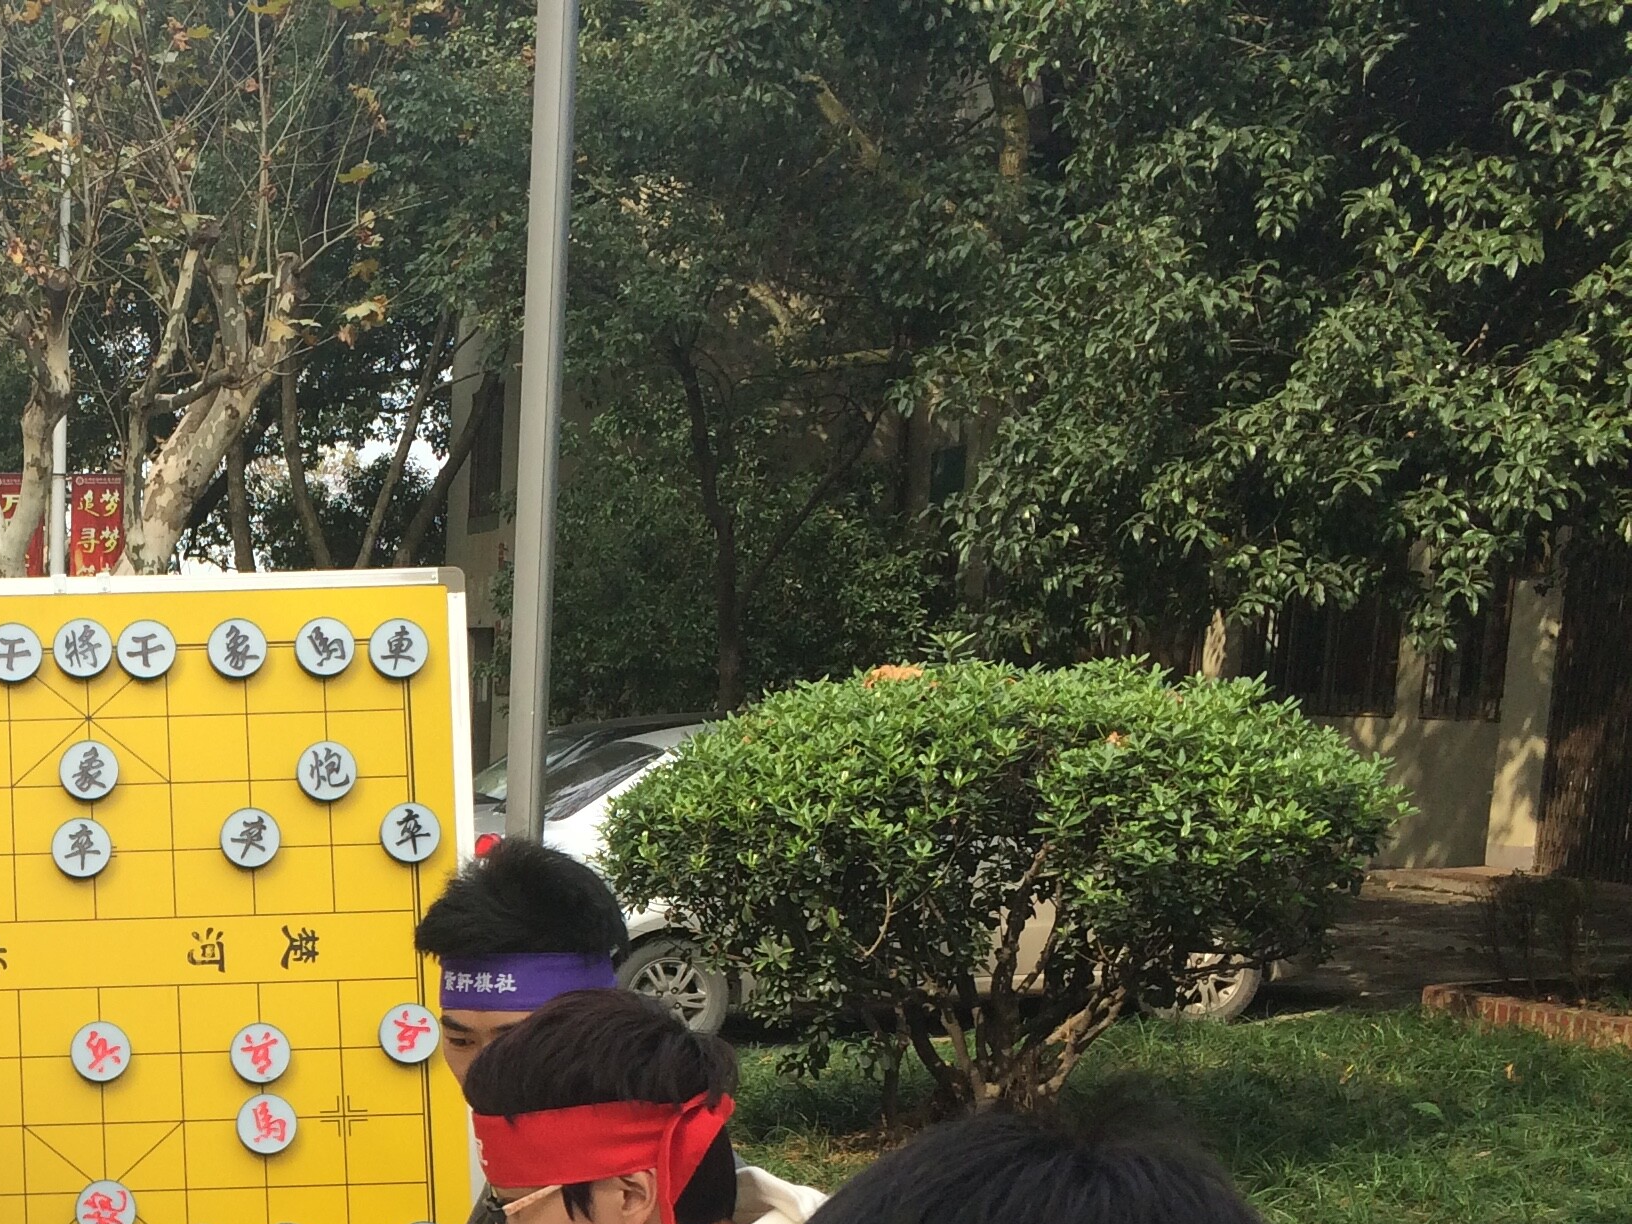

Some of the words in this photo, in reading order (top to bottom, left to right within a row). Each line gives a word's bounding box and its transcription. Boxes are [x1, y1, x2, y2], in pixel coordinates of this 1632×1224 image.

[223, 625, 259, 670] 象
[380, 625, 416, 670] 車
[72, 746, 107, 792] 象
[309, 747, 350, 791] 炮
